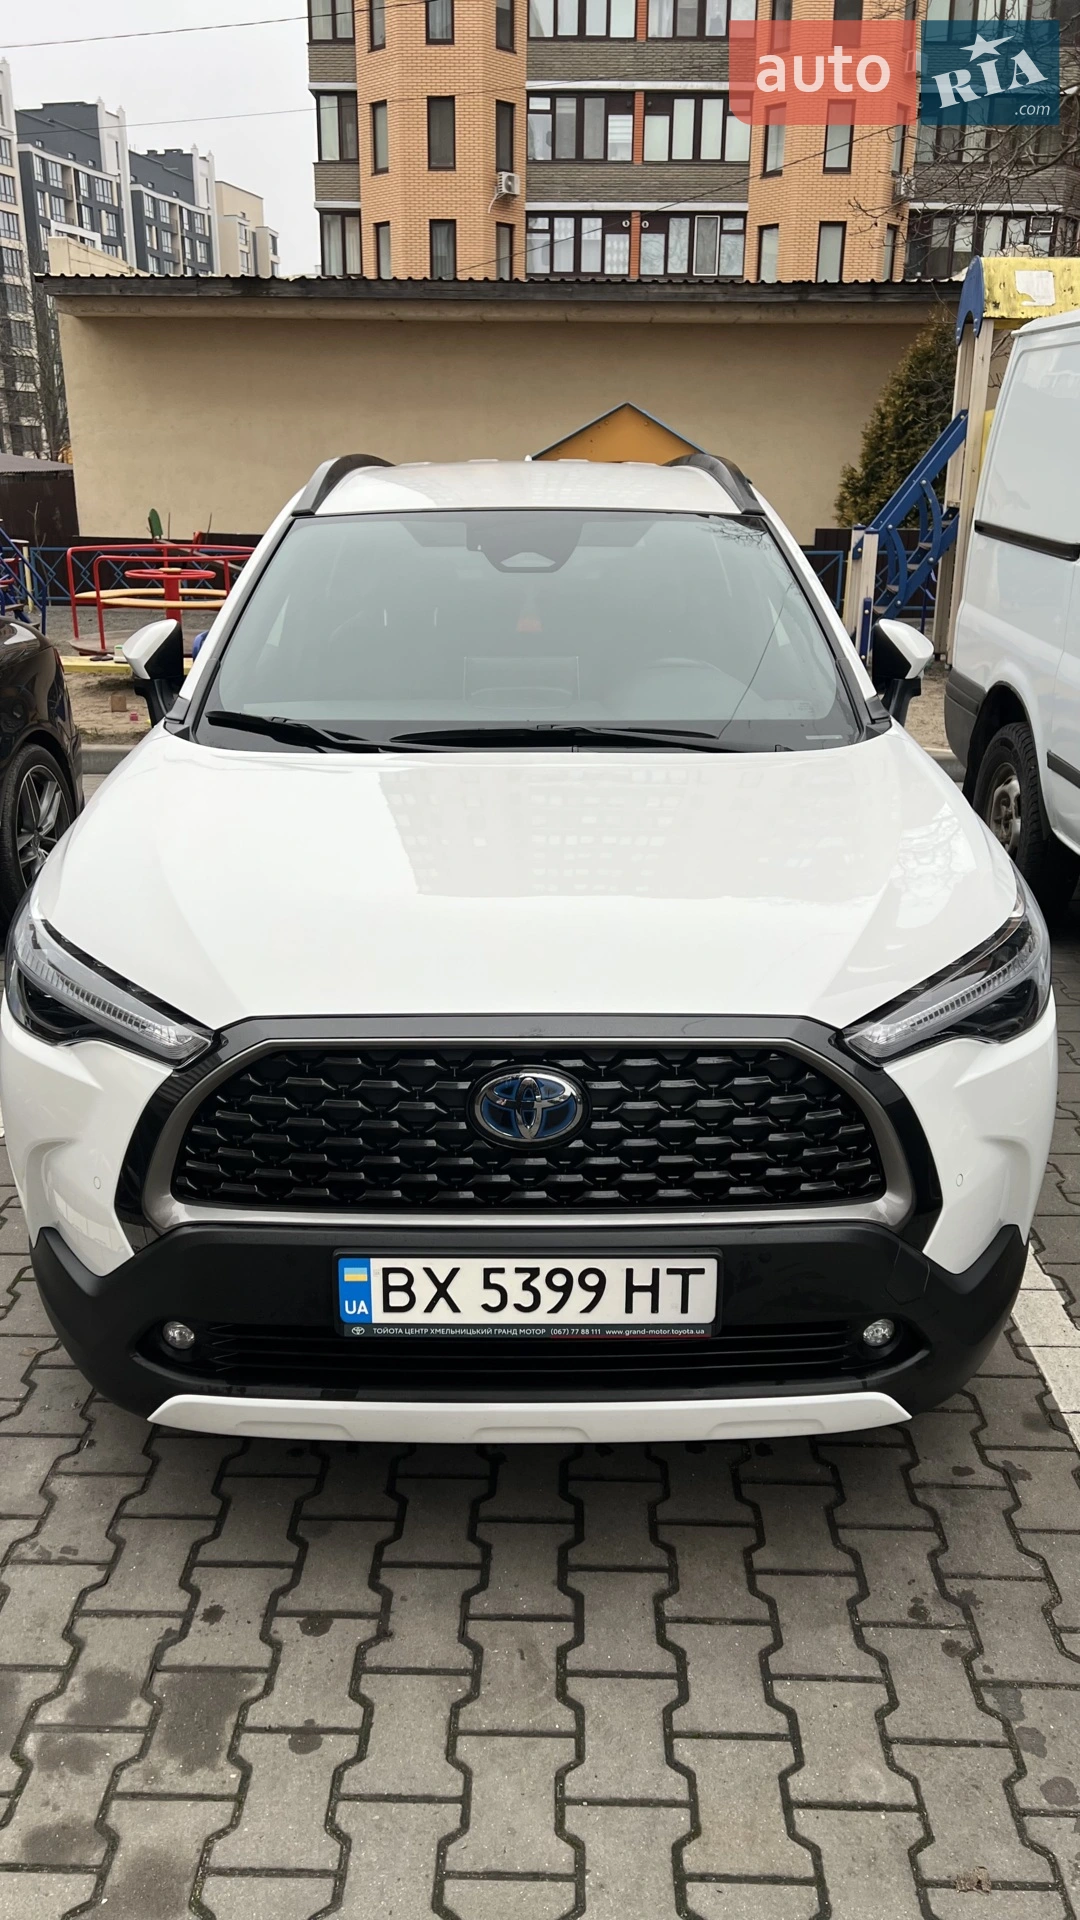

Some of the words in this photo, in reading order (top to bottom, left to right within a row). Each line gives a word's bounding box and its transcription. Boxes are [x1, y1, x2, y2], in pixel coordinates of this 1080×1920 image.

[481, 1267, 606, 1314] 5399
[345, 1300, 369, 1315] UA
[373, 1326, 403, 1335] ТОЙОТА
[405, 1327, 428, 1335] ЦЕНТР
[430, 1326, 493, 1335] ХМЕЛЬНИЦЬКИЙ
[550, 1328, 568, 1336] (067)
[605, 1328, 705, 1336] www.grand-motor.toyota.ua
